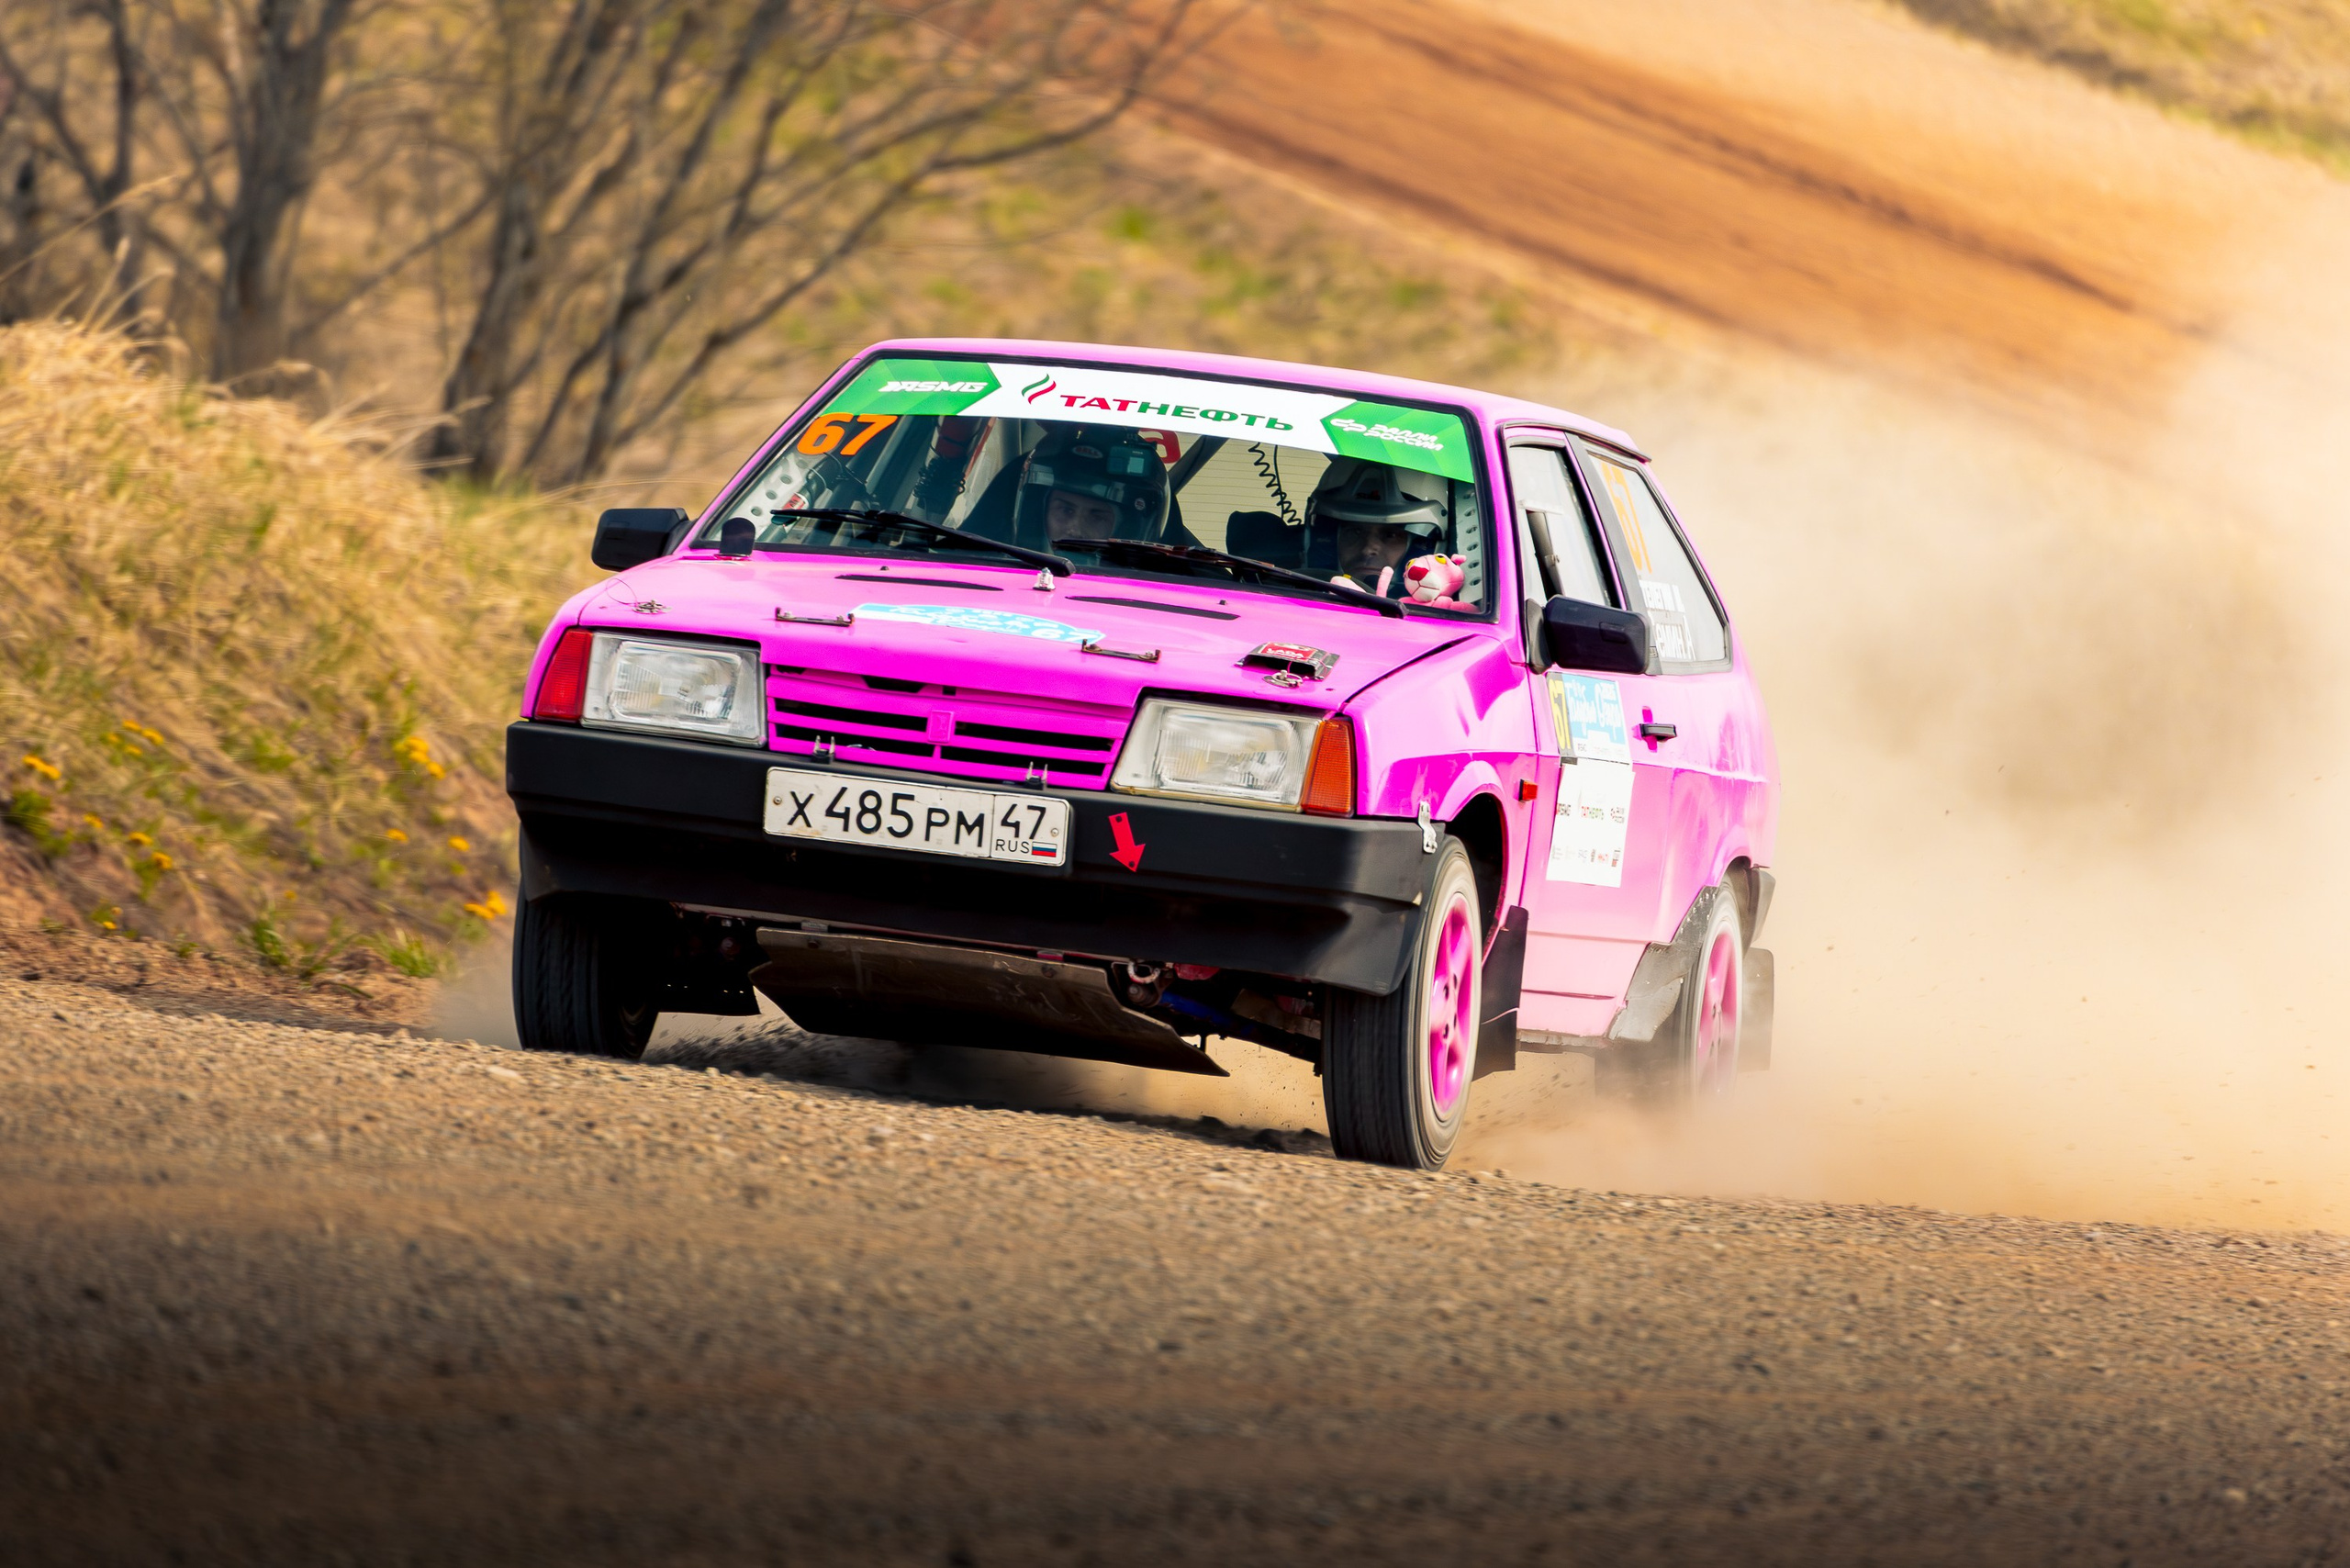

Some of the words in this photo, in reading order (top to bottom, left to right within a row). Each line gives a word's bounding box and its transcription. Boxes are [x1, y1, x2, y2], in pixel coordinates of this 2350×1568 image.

[1060, 395, 1293, 431] ТАТНЕФТЬ
[797, 412, 898, 455] 67
[1601, 461, 1652, 574] 67
[1031, 628, 1099, 643] 67
[1549, 679, 1572, 749] 67
[1001, 803, 1046, 839] 47
[995, 839, 1030, 854] RUS
